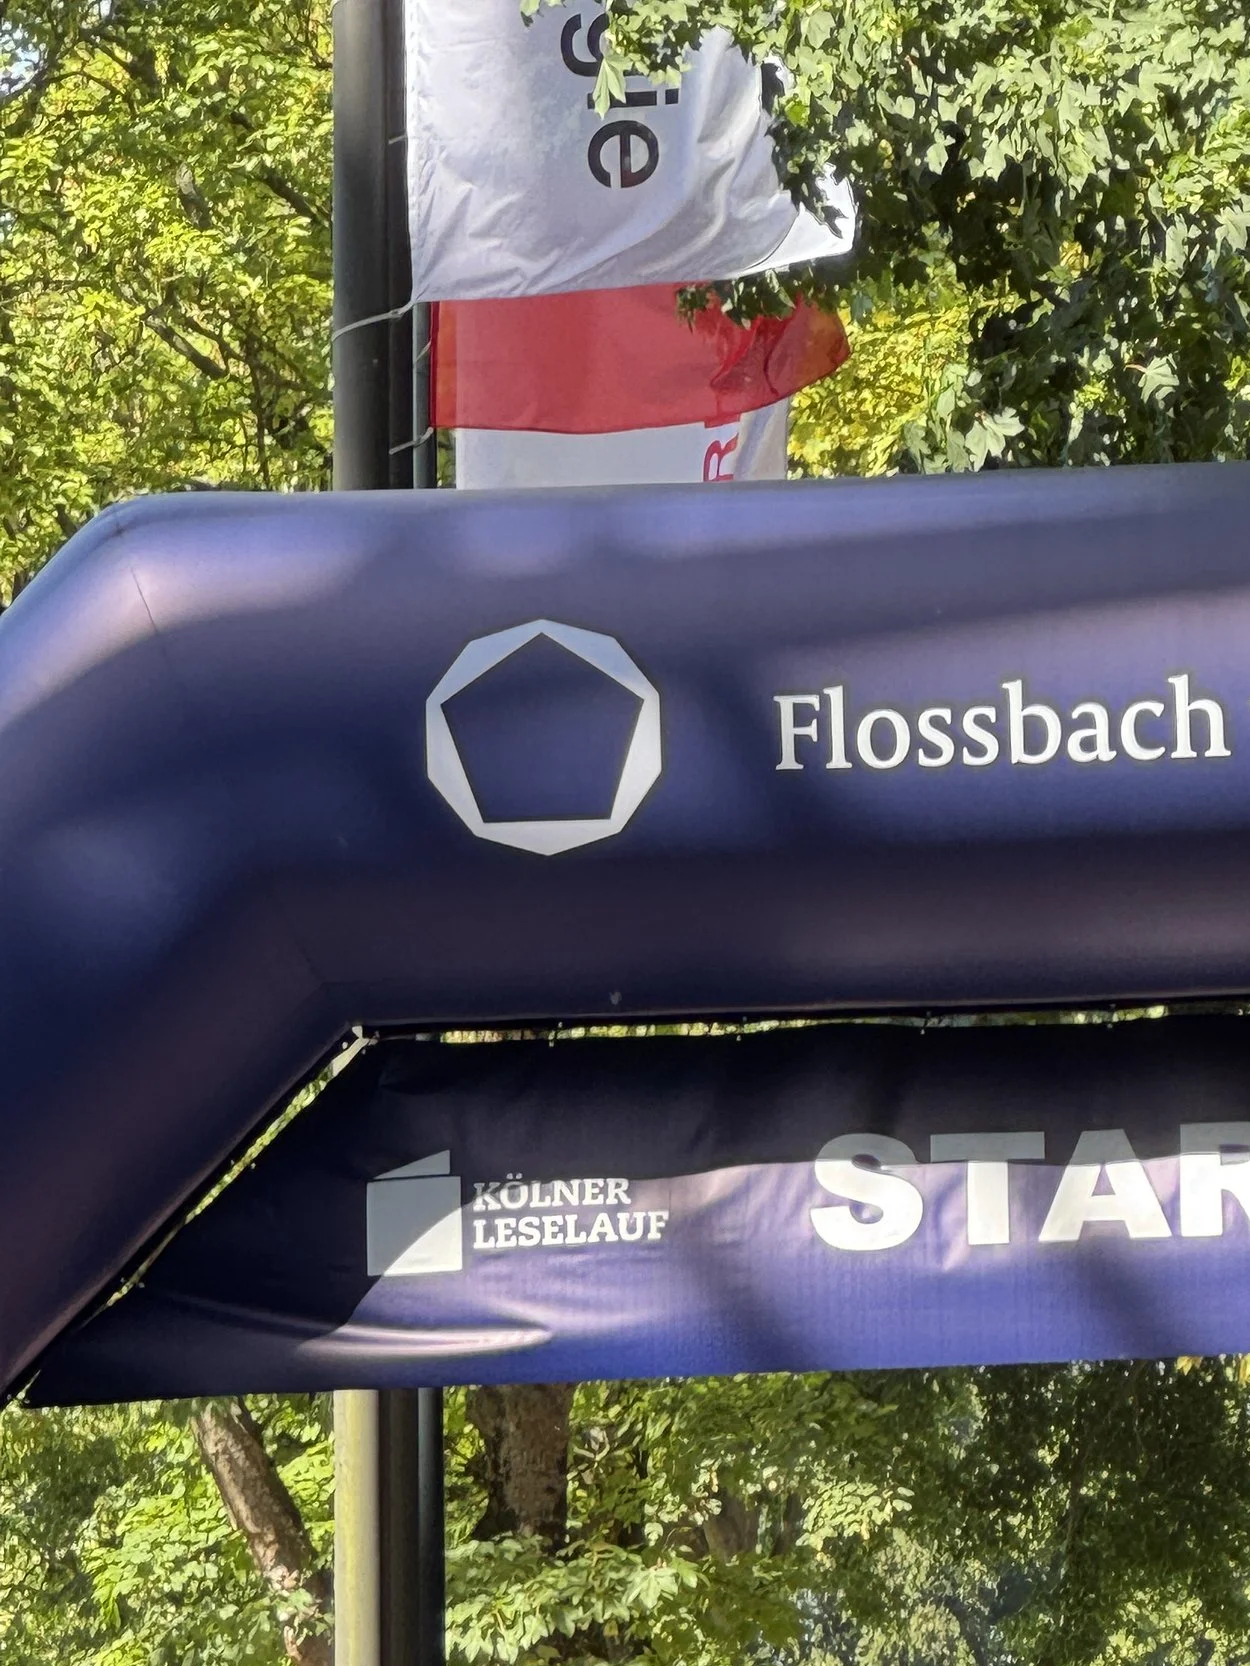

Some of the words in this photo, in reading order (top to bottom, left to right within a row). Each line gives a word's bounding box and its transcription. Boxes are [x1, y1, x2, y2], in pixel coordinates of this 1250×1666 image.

[773, 673, 1231, 772] Flossbach
[472, 1172, 632, 1212] KÖLNER
[473, 1210, 669, 1250] LESELAUF
